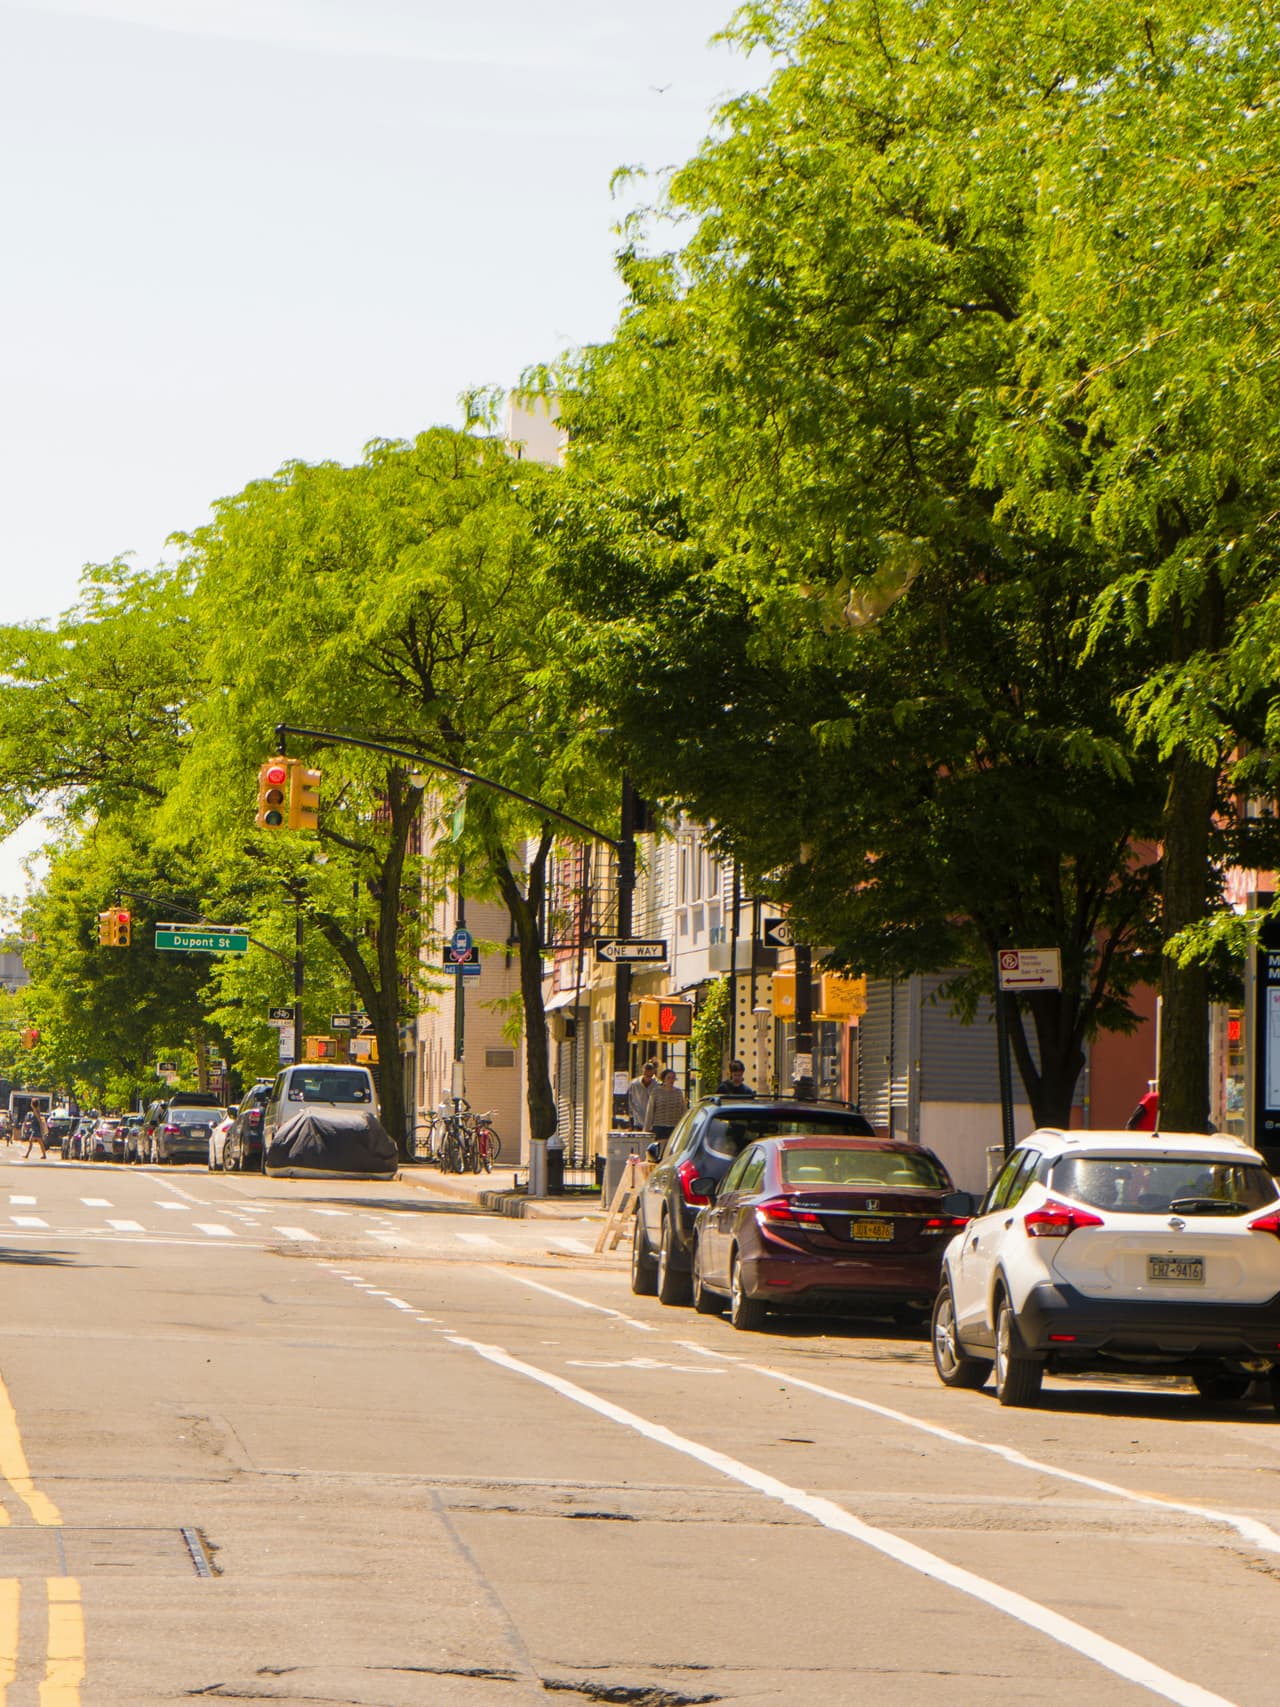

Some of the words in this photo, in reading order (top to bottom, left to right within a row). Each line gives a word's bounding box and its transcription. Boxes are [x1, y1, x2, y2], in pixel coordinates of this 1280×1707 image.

[173, 936, 214, 948] Dupont
[218, 938, 231, 948] St
[606, 946, 627, 956] ONE
[637, 946, 658, 956] WAY
